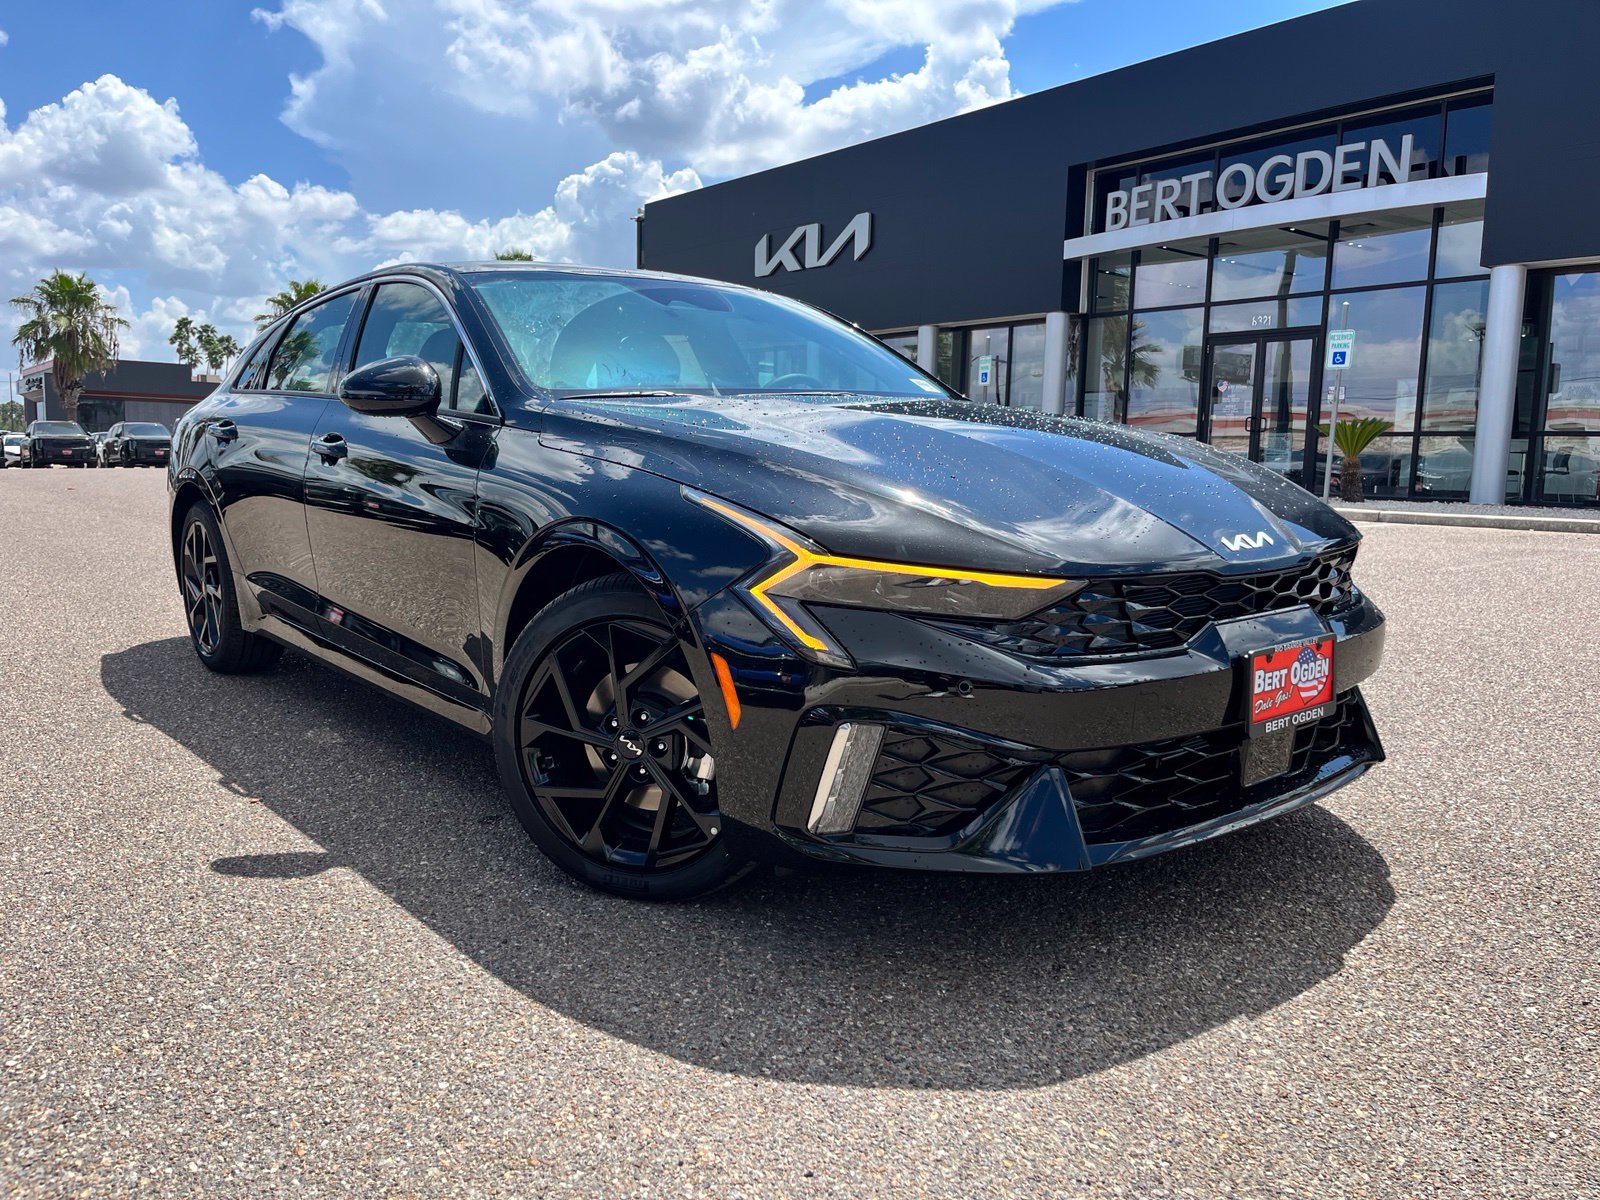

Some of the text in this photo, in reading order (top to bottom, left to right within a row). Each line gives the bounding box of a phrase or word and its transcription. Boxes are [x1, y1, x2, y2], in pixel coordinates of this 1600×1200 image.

[1105, 133, 1414, 233] BERT OGDEN
[754, 211, 871, 278] KIA
[1221, 531, 1274, 551] KIA
[1254, 658, 1329, 694] BERT OGDEN
[1255, 697, 1274, 714] Dale
[1265, 706, 1325, 733] BERT OGDEN
